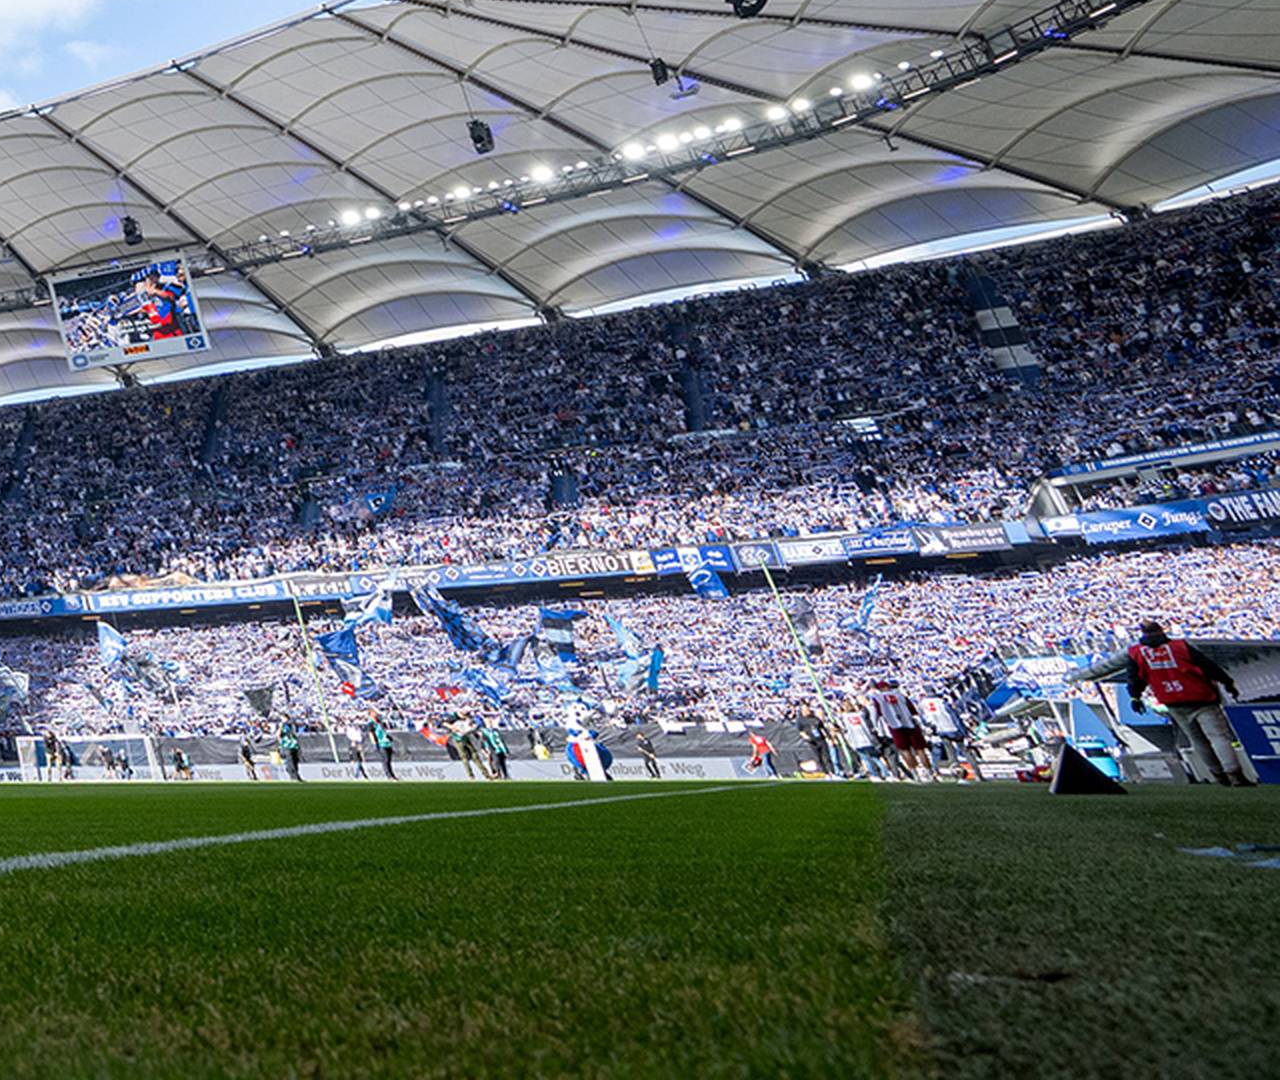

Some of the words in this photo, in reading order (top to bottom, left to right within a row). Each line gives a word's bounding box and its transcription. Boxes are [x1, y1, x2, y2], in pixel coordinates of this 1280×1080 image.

[1220, 496, 1259, 521] THE
[547, 555, 629, 576] BIERNOT
[236, 584, 277, 598] CLUB
